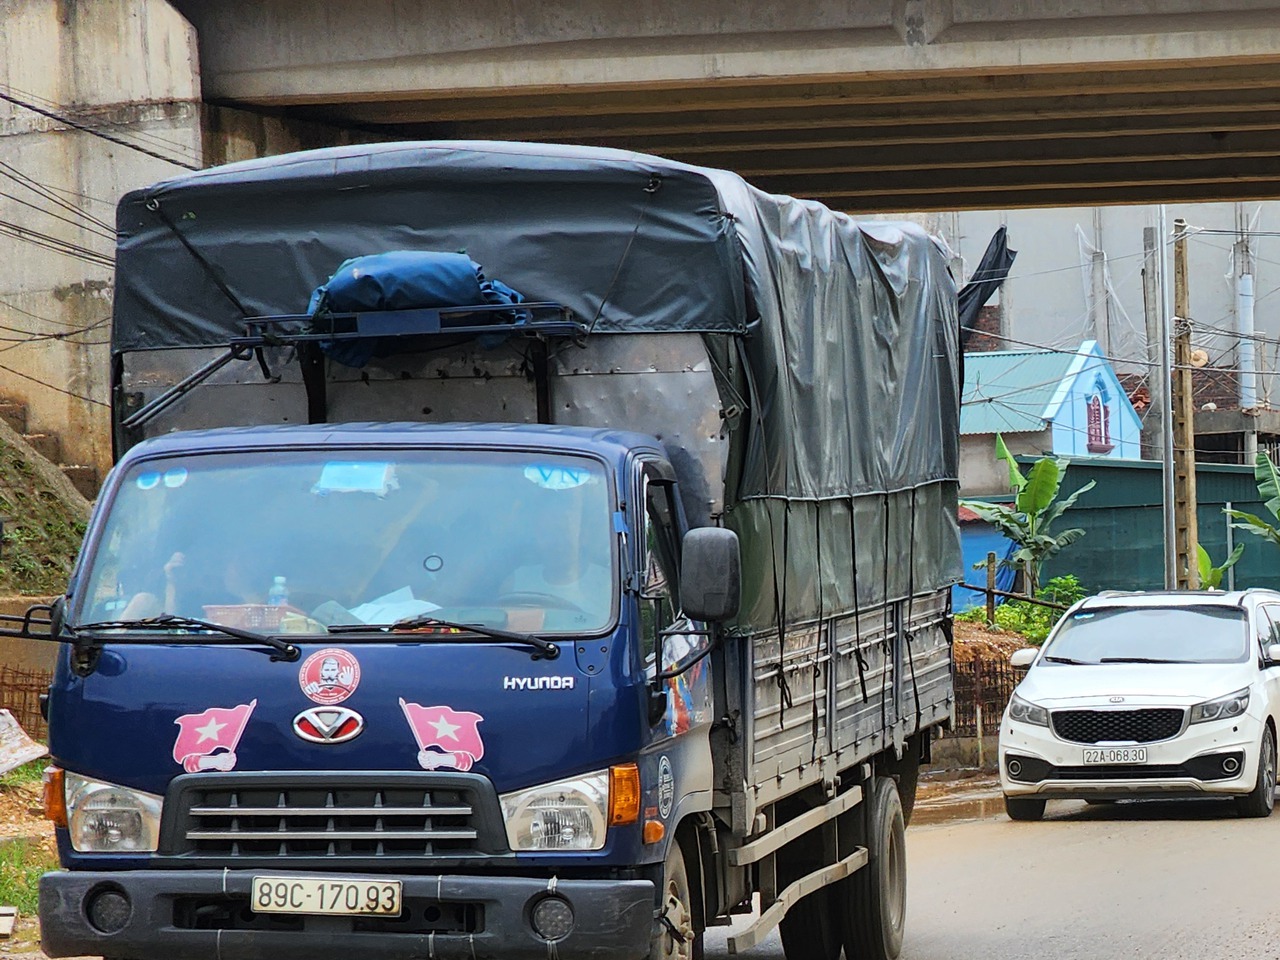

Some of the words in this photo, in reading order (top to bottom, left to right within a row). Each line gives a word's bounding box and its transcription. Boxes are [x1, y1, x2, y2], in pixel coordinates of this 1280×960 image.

[536, 466, 581, 484] VN
[1085, 749, 1145, 763] 22A-068.30
[258, 882, 396, 911] 89C-170.93
